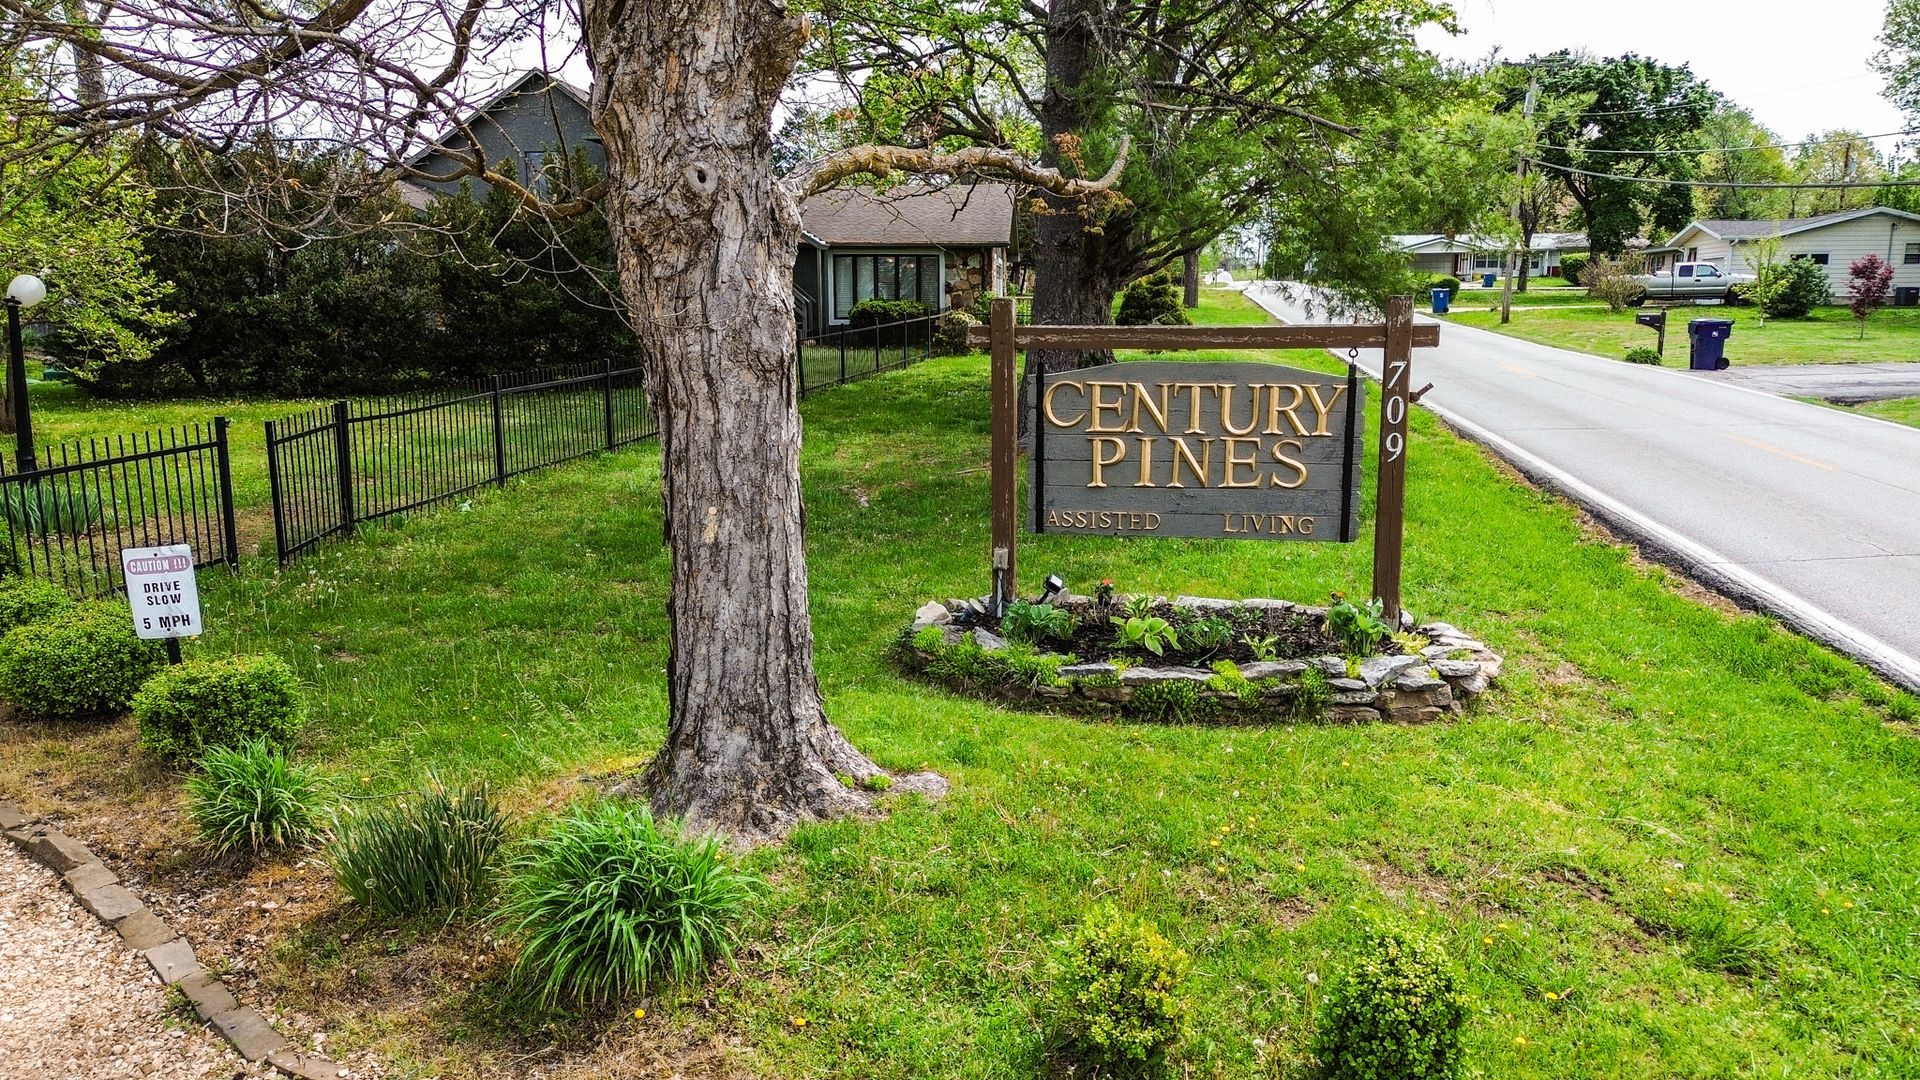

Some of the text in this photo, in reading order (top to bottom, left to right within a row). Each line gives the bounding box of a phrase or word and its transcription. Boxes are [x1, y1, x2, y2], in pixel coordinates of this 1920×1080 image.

[1043, 380, 1347, 437] CENTURY
[1386, 361, 1407, 462] 709
[1087, 436, 1309, 489] PINES
[1045, 510, 1314, 535] ASSISTED LIVING
[130, 559, 170, 573] CAUTION
[143, 580, 181, 593] DRIVE
[146, 593, 181, 606] SLOW
[143, 614, 191, 630] 5 MPH
